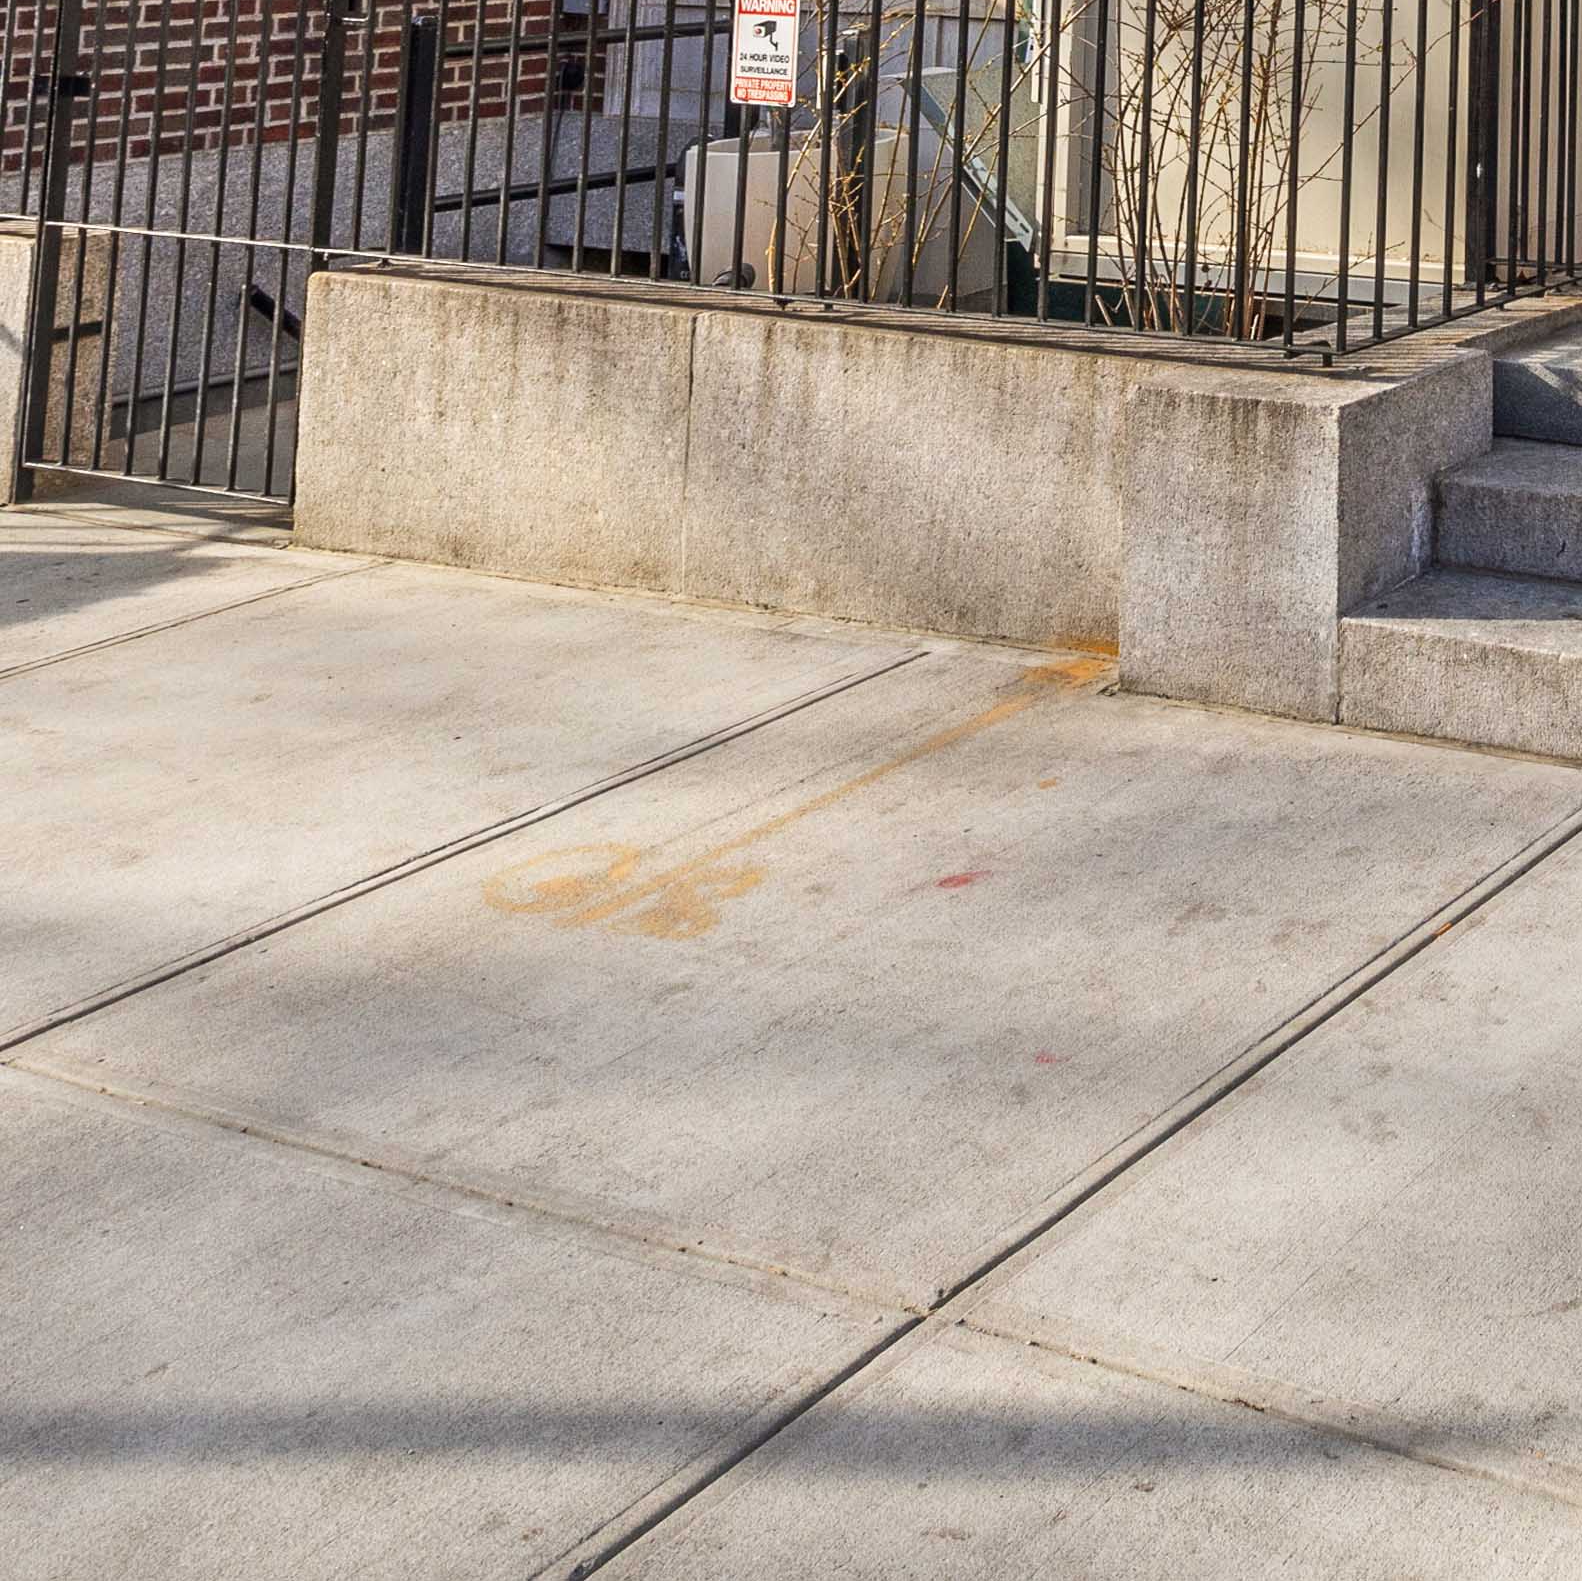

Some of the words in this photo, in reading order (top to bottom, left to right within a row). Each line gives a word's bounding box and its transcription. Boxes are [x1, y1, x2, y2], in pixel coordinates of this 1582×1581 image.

[740, 52, 748, 61] 24
[749, 53, 767, 62] HOUR
[769, 54, 790, 64] VIDEO
[740, 65, 788, 75] SURVEILLANCE
